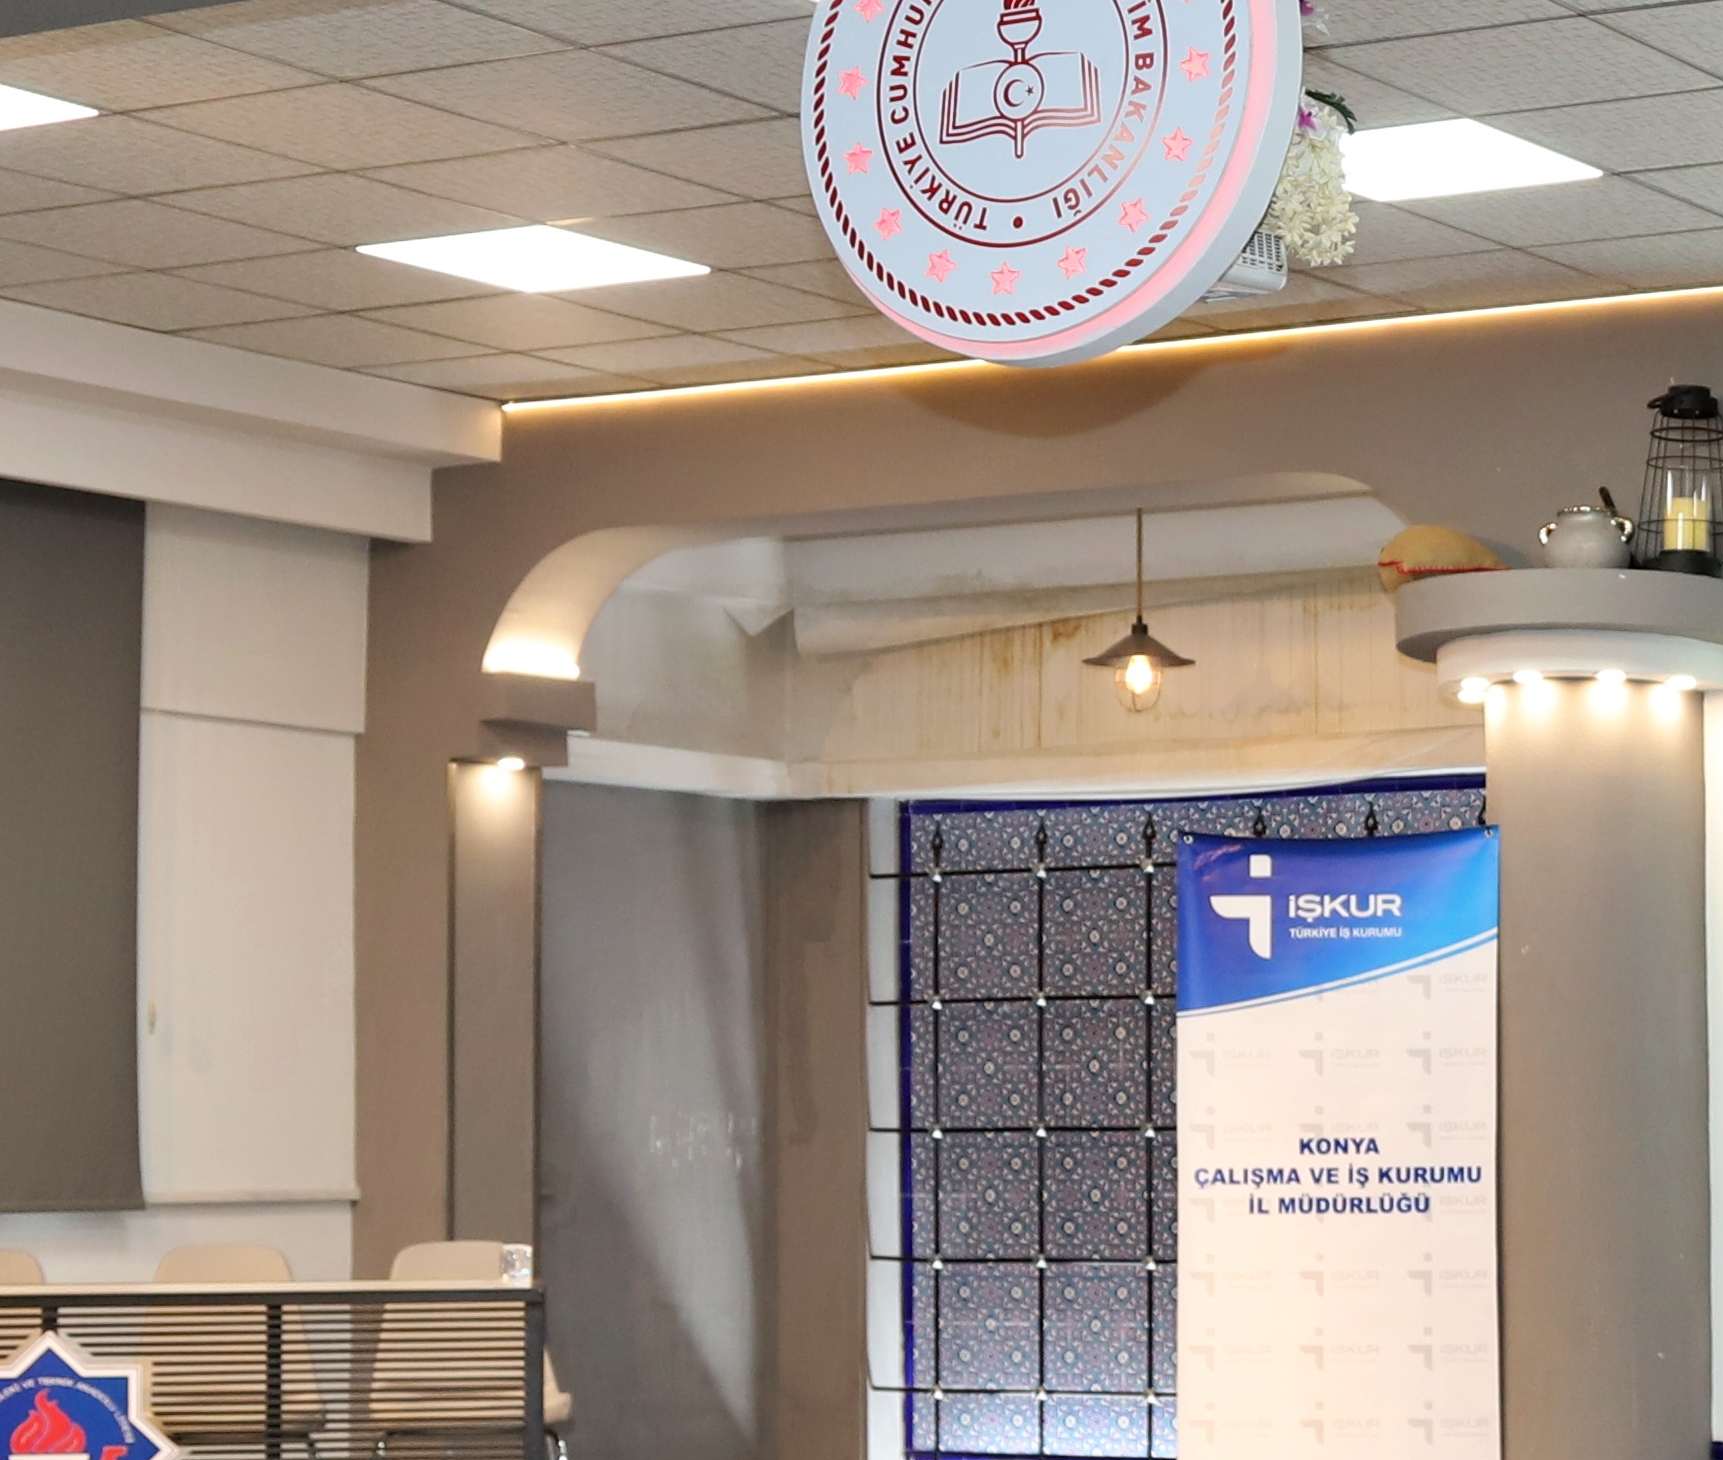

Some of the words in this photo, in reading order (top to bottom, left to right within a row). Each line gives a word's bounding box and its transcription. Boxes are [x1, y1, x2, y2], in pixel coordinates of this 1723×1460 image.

[1051, 52, 1154, 219] BAKANLIĞI
[895, 131, 988, 231] TÜRKİYE
[1288, 893, 1403, 922] İŞKUR
[1289, 926, 1337, 939] TÜRKİYE
[1339, 925, 1350, 941] İŞ
[1352, 926, 1402, 938] KURUMU
[1299, 1137, 1380, 1156] KONYA
[1194, 1168, 1301, 1188] ÇALIŞMA
[1311, 1167, 1339, 1184] VE
[1348, 1163, 1370, 1187] İŞ
[1378, 1166, 1482, 1184] KURUMU
[1248, 1193, 1269, 1214] İL
[1278, 1193, 1431, 1214] MÜDÜRLÜĞÜ
